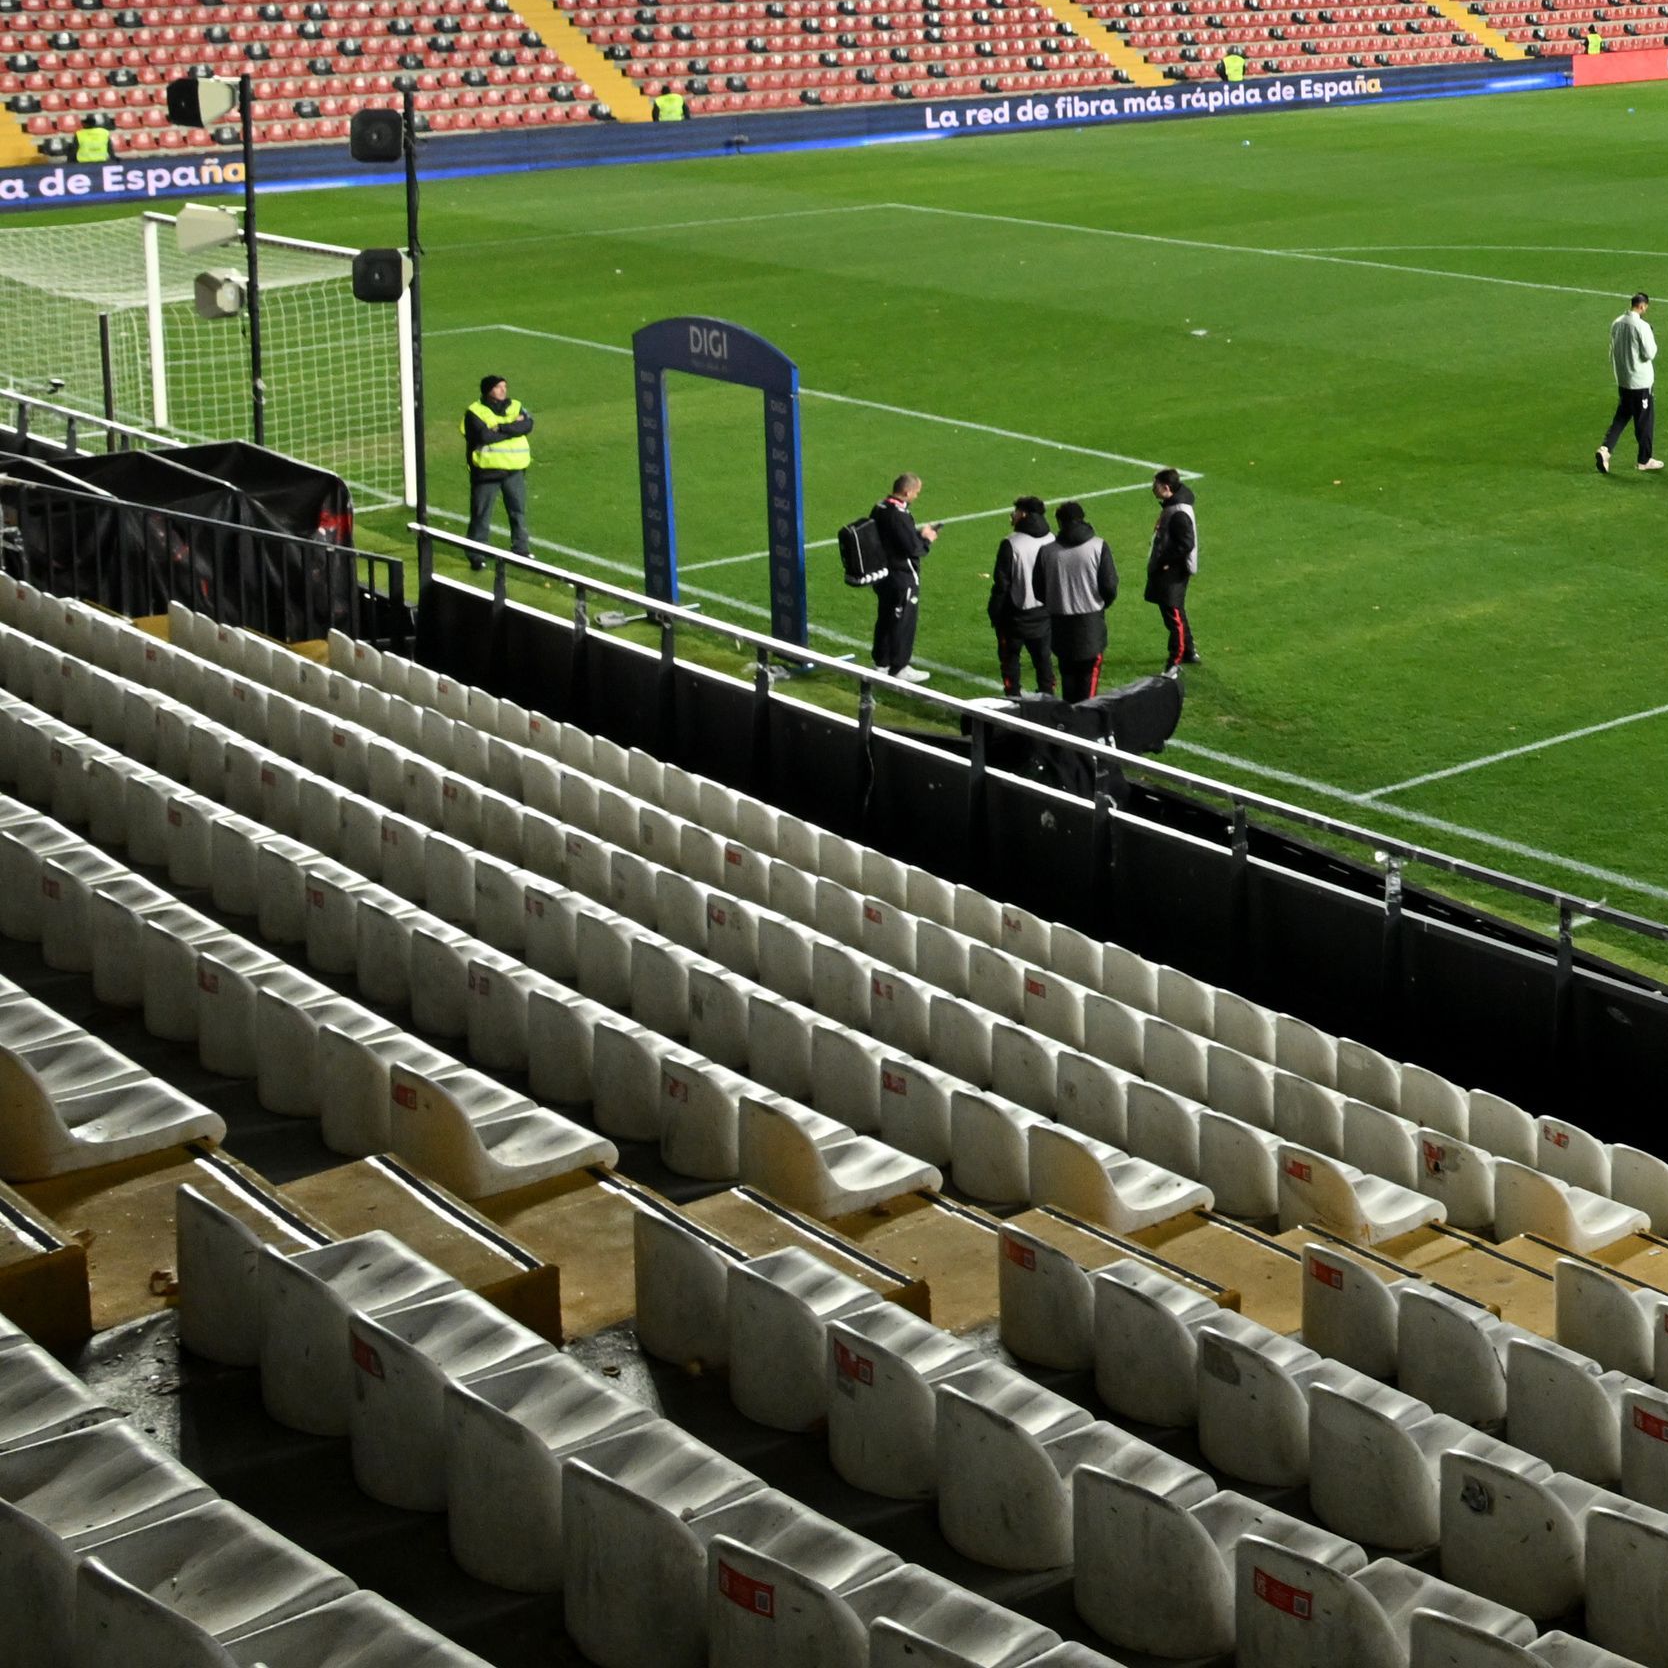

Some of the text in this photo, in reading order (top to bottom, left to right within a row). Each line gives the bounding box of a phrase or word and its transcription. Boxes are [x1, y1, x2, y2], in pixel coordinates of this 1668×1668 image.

[925, 76, 1382, 129] La red de fibra más rápida de España
[38, 168, 91, 197] de
[102, 158, 247, 197] España
[689, 325, 728, 360] DIGI
